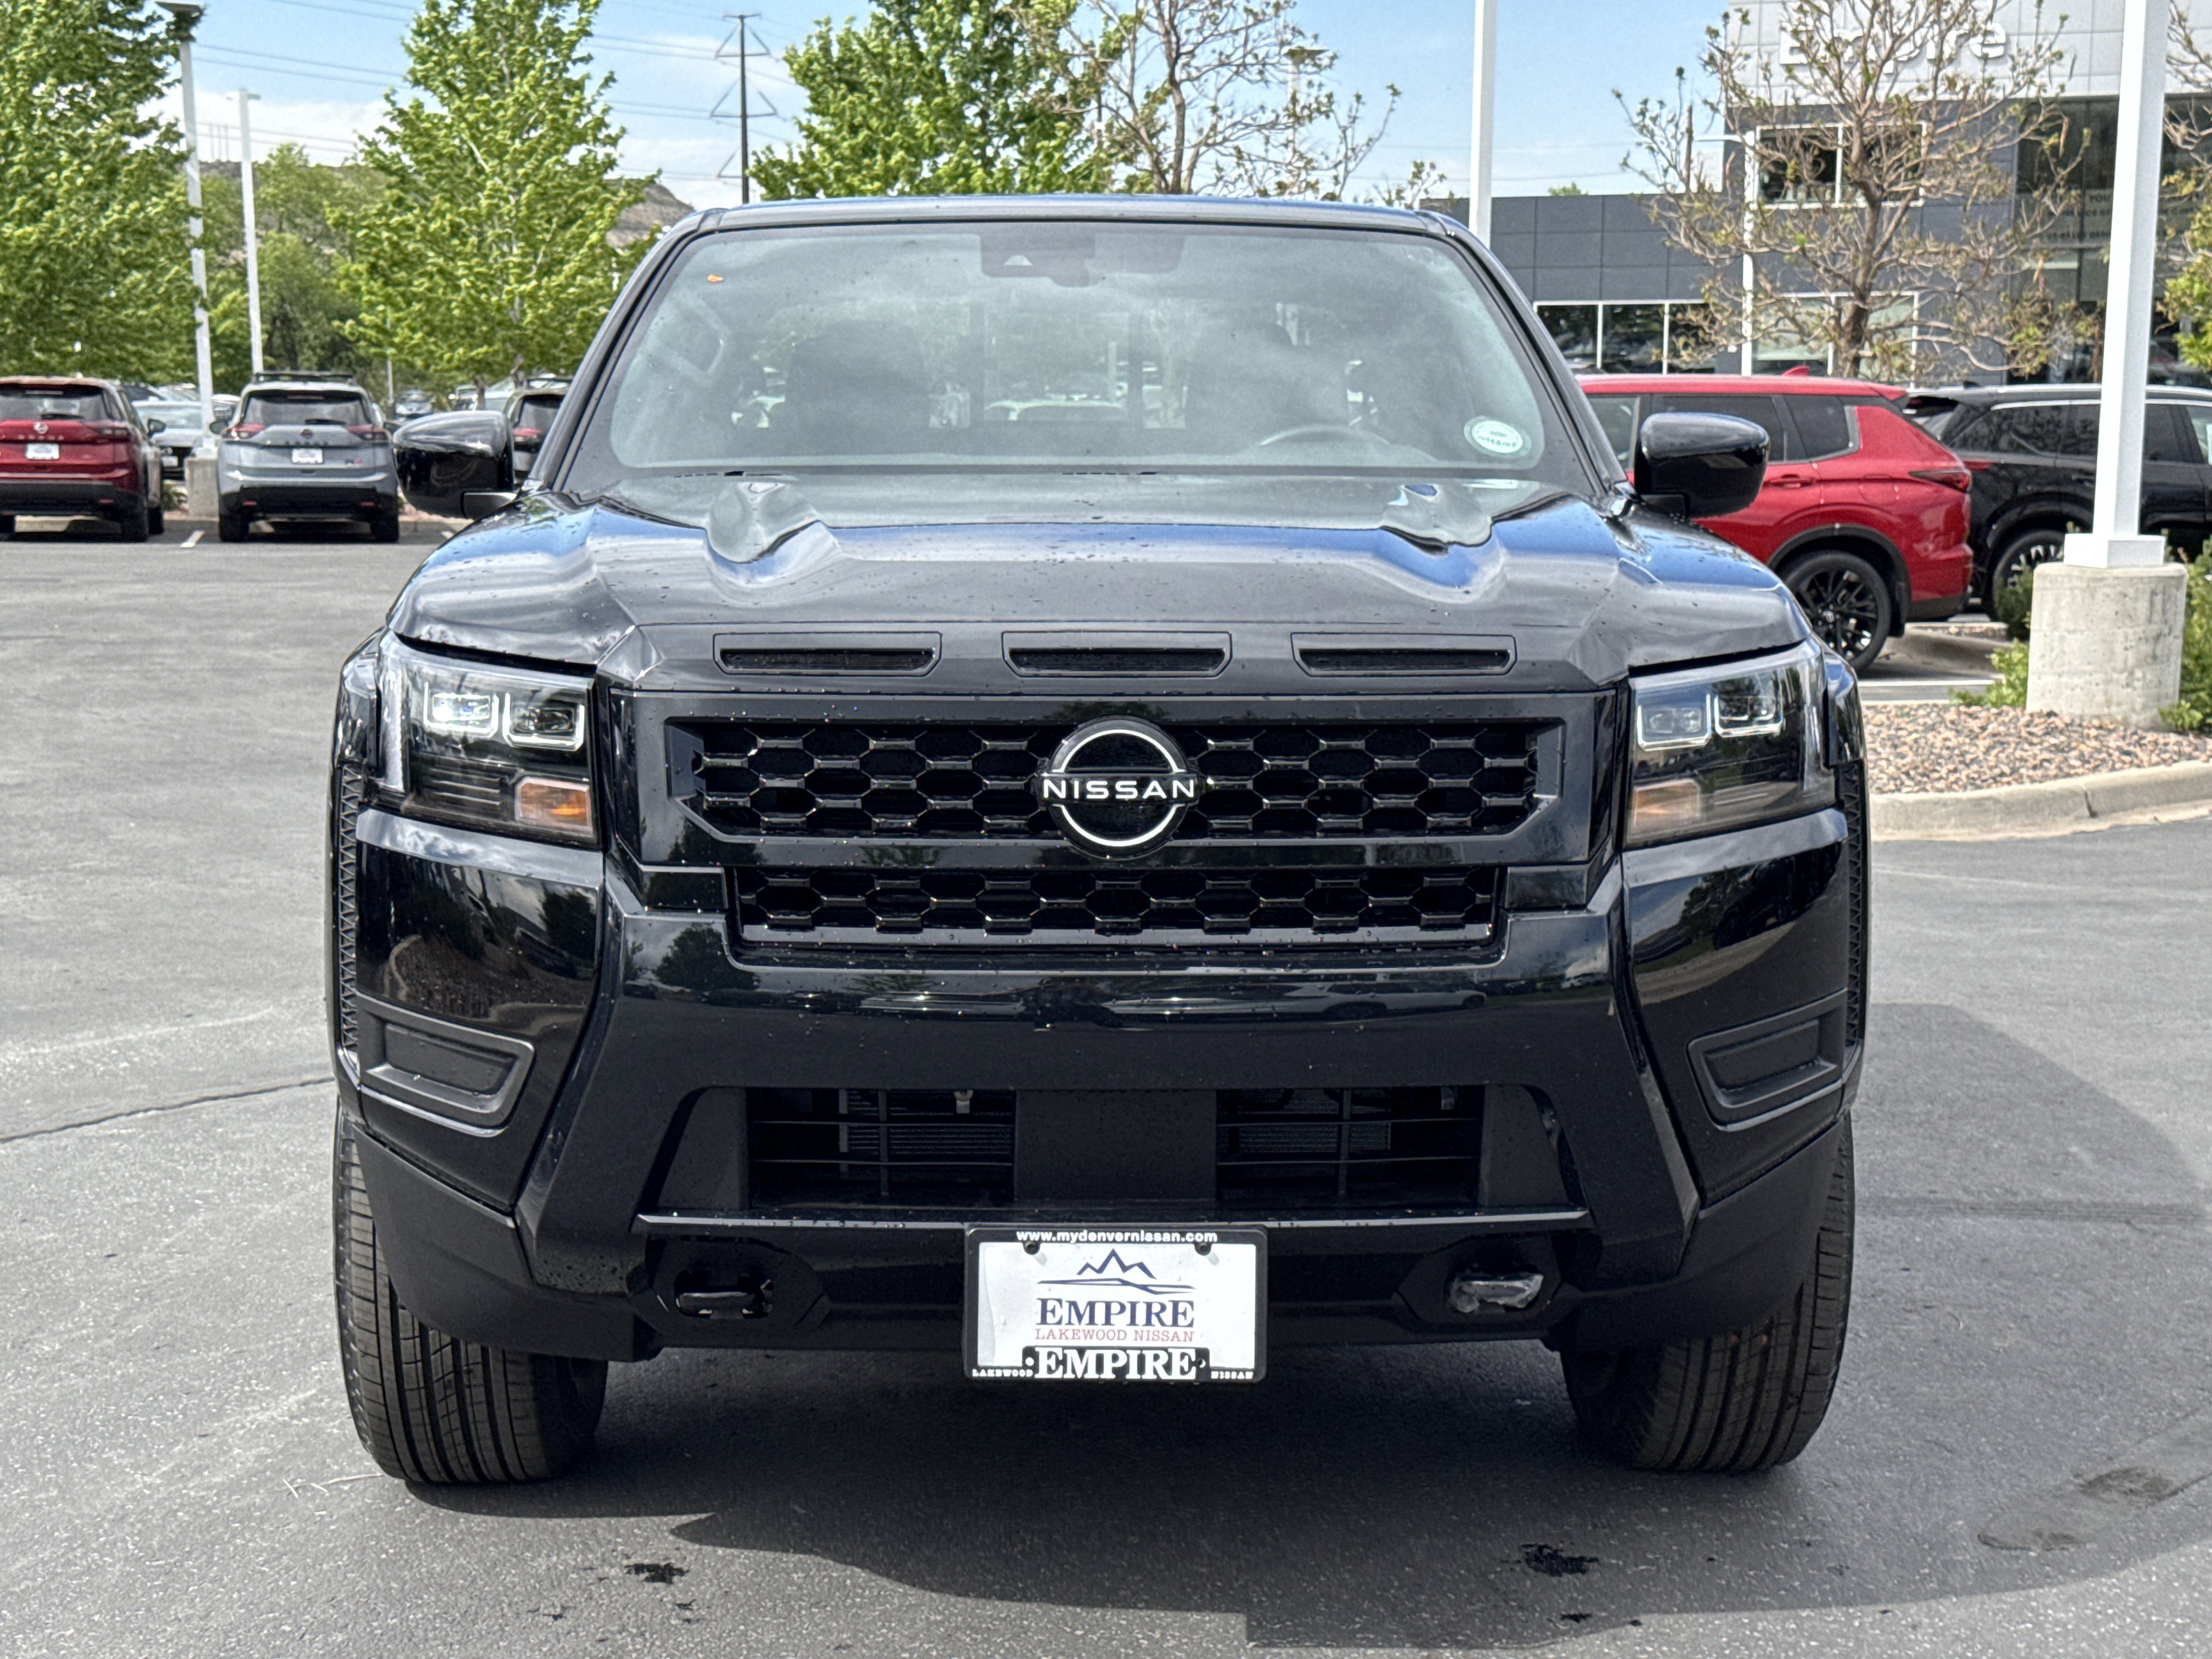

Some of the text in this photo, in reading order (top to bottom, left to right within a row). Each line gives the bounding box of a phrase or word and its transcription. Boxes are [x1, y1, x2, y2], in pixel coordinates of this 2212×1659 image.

[1043, 779, 1194, 799] NISSAN
[1016, 1229, 1217, 1244] www.mydenvernissan.com
[1036, 1297, 1194, 1328] EMPIRE
[1035, 1328, 1195, 1342] LAKEWOOD NISSAN
[1035, 1347, 1196, 1380] EMPIRE
[972, 1369, 1034, 1377] LAKEWOOD
[1211, 1371, 1254, 1379] NISSAN
